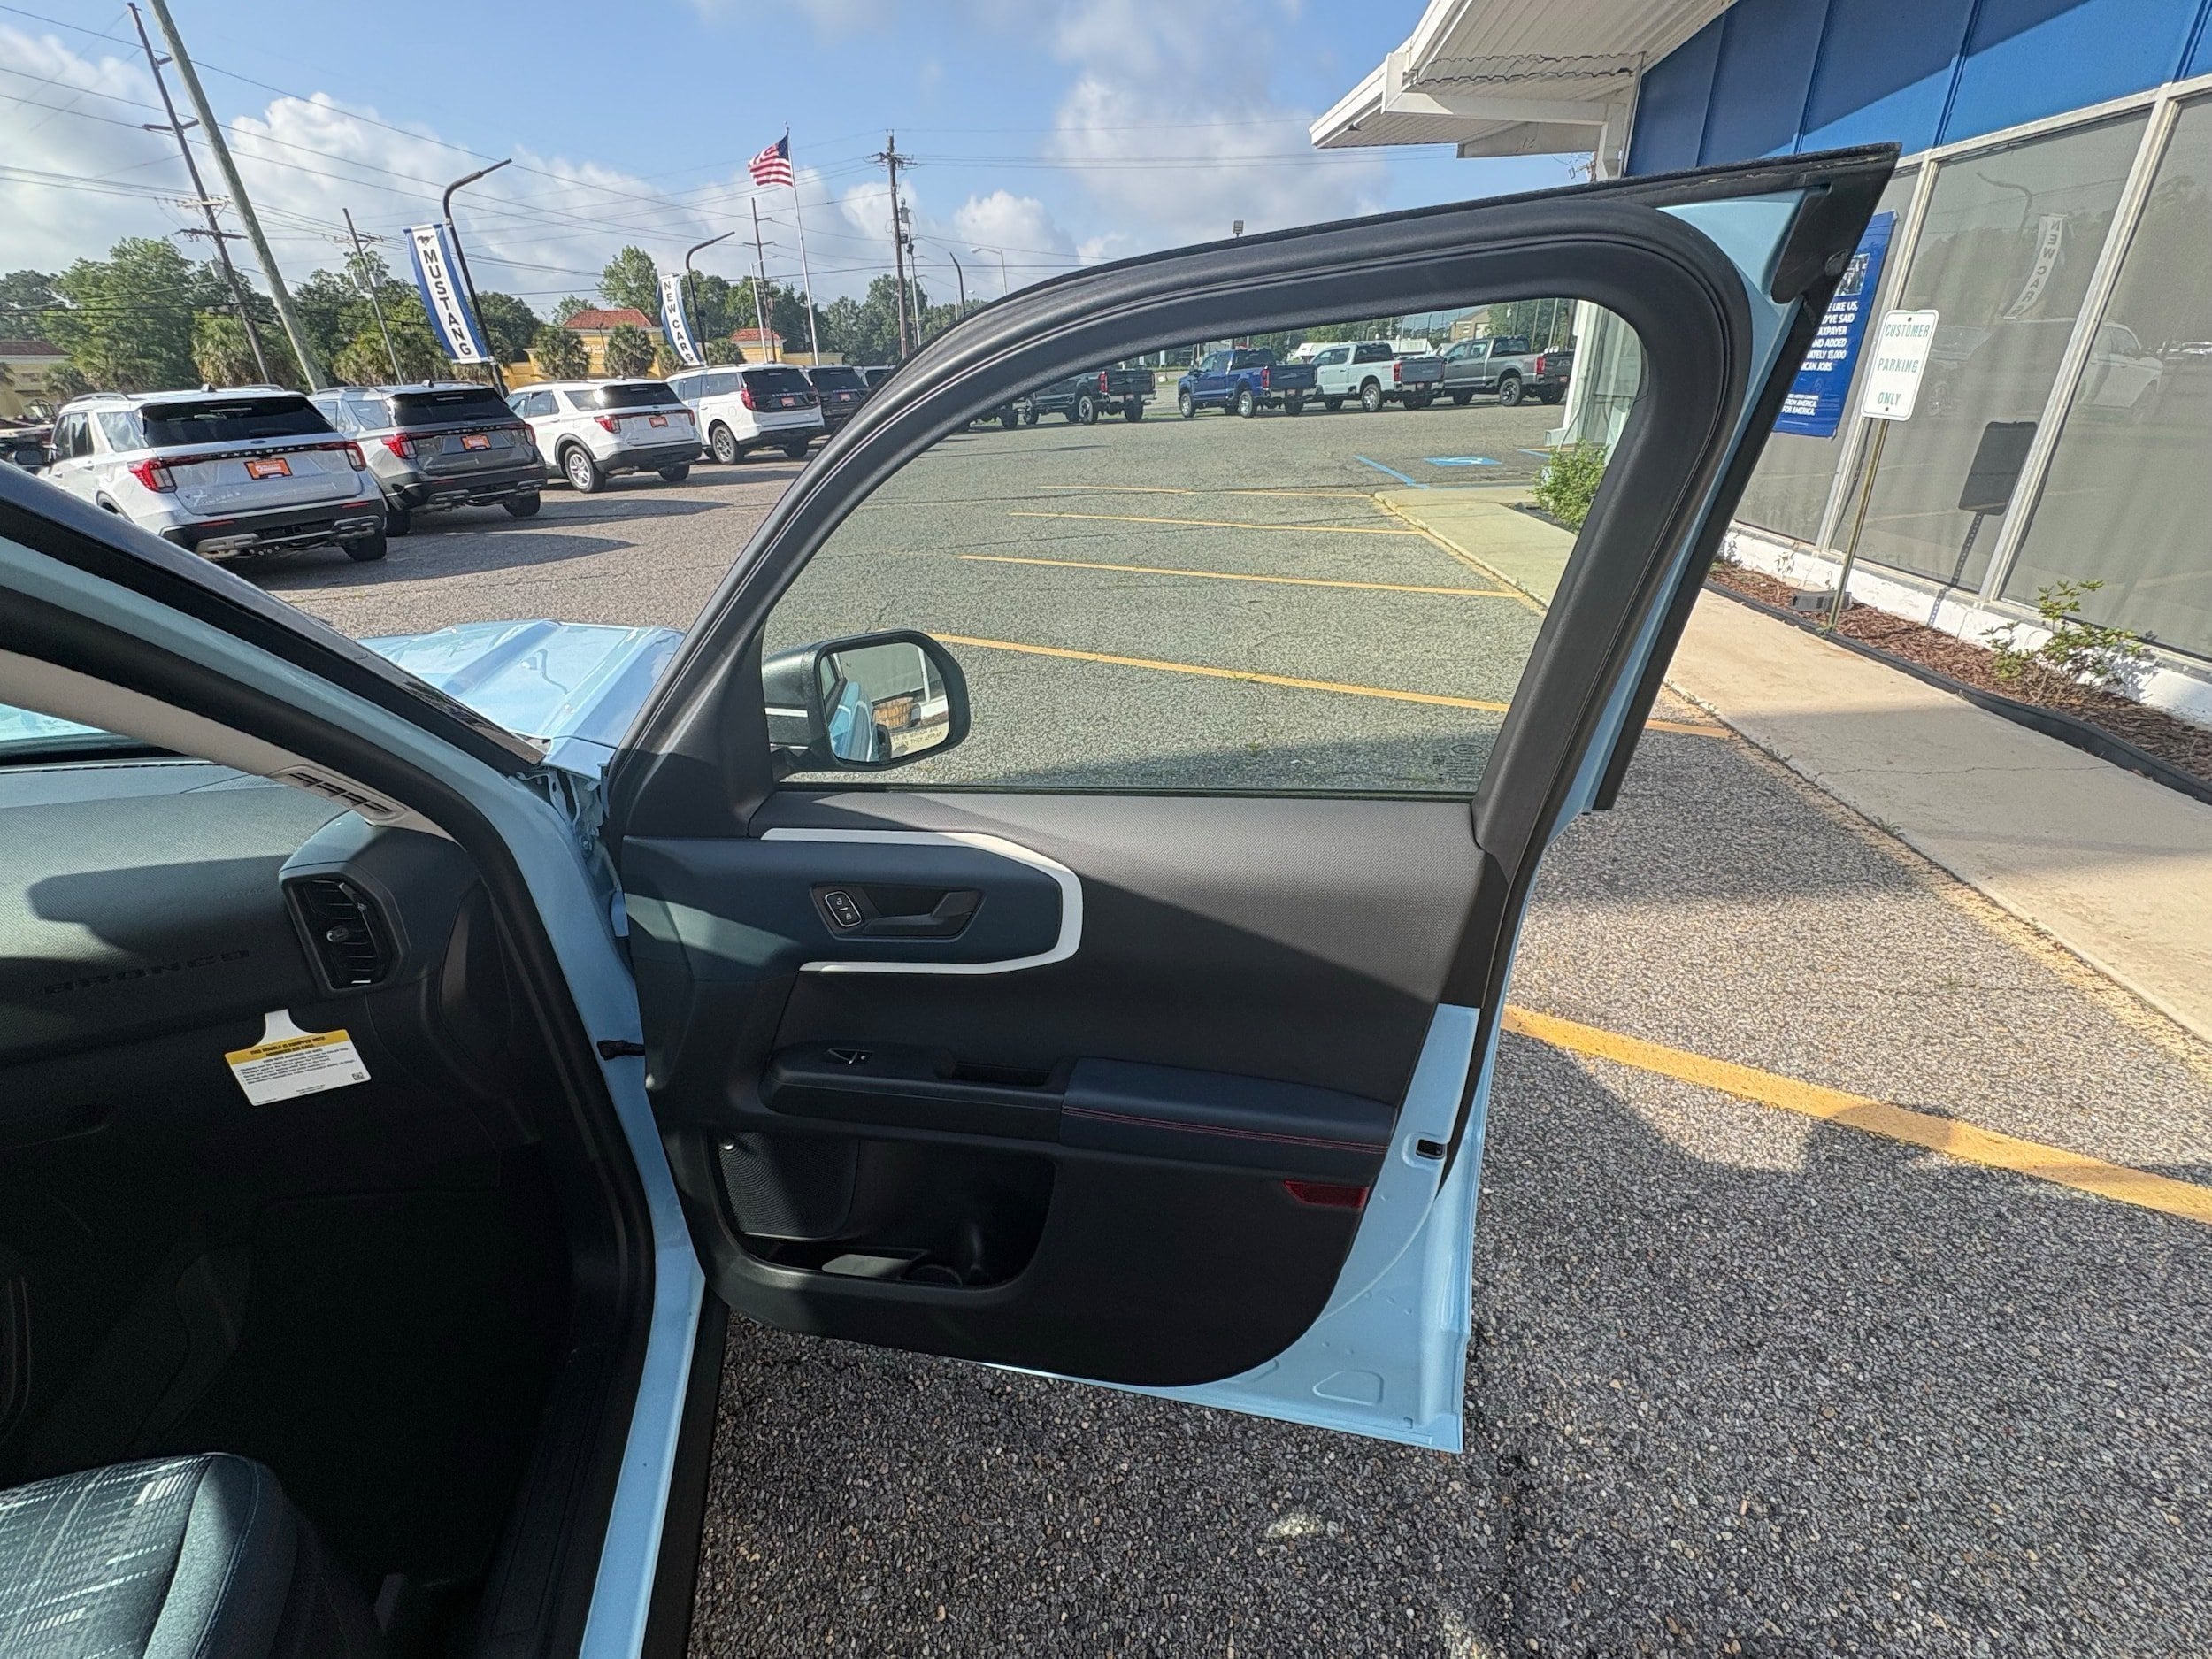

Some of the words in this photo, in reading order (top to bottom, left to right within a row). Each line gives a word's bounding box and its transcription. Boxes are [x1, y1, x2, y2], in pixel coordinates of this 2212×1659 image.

[423, 249, 472, 356] MUSTANG
[1832, 302, 1847, 311] LIKE
[664, 280, 676, 314] NEW
[672, 319, 694, 362] CARS
[1838, 313, 1855, 324] SAID
[1816, 326, 1848, 336] AXPAYER
[1885, 324, 1931, 338] CUSTOMER
[1824, 337, 1847, 348] ADDED
[1877, 357, 1919, 373] PARKING
[1877, 392, 1901, 406] ONLY
[43, 949, 250, 995] BRONCO
